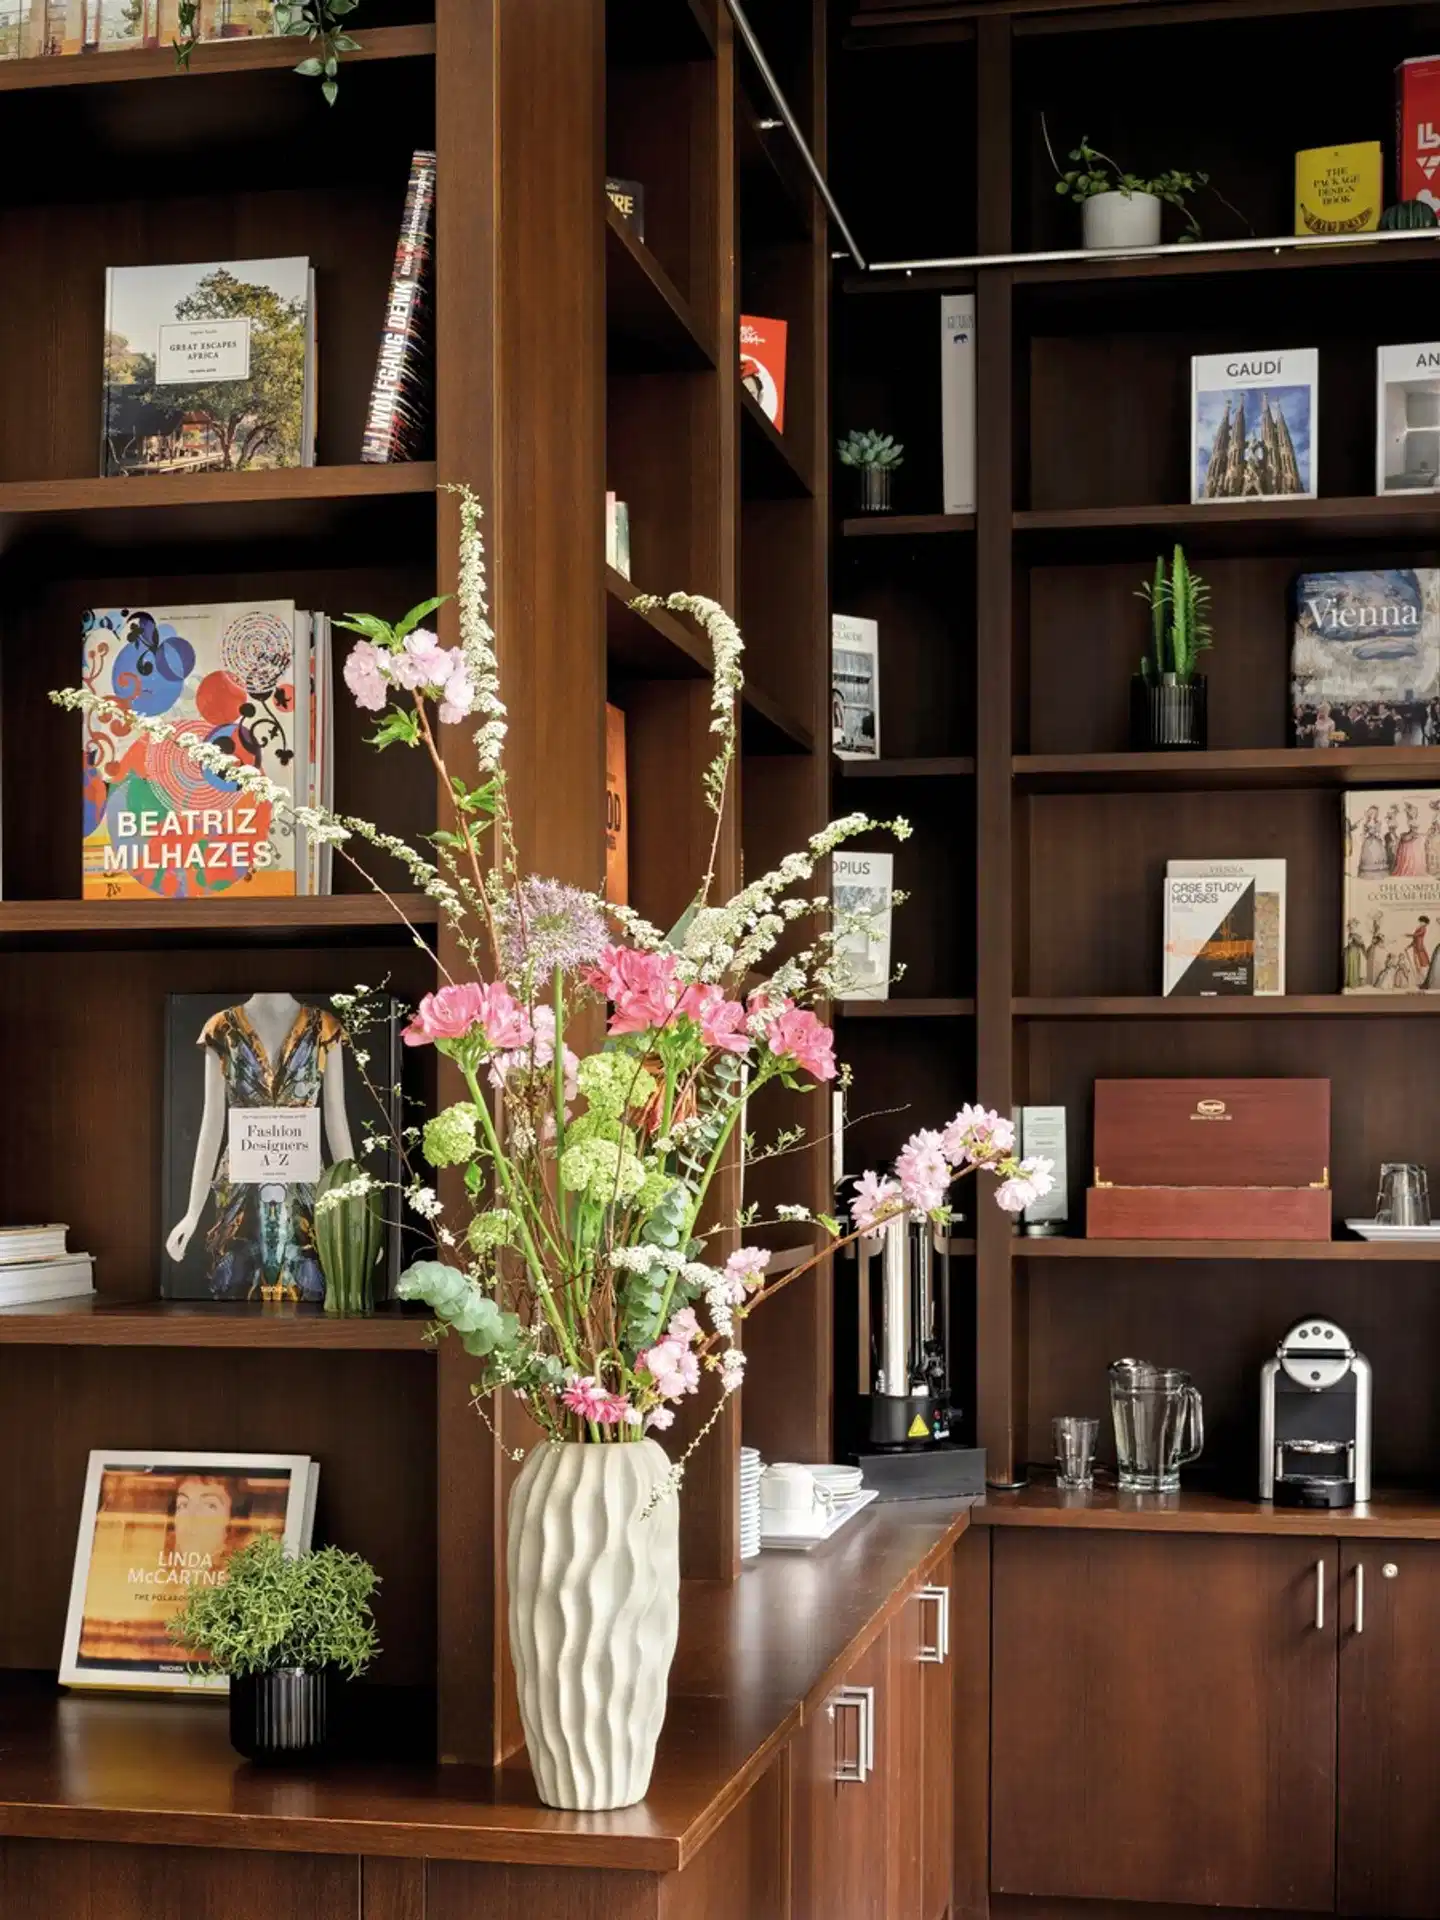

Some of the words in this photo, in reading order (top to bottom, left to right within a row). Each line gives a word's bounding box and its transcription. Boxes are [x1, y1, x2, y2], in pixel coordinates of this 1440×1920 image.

[1325, 167, 1349, 177] THE
[1312, 173, 1361, 188] PACKAGE
[1317, 185, 1356, 197] DESIGN
[169, 343, 199, 351] GREAT
[200, 340, 238, 349] ESCAPES
[187, 352, 219, 360] AFRICA
[369, 332, 405, 430] WOLFGANG
[387, 281, 415, 330] DENK
[1416, 352, 1440, 367] AN
[1226, 356, 1284, 377] GAUDÍ
[1304, 598, 1420, 628] Vienna
[117, 808, 257, 837] BEATRIZ
[103, 841, 272, 870] MILHAZES
[1171, 882, 1203, 894] CASE
[1205, 881, 1243, 893] STUDY
[1171, 893, 1220, 904] HOUSES
[247, 1124, 302, 1137] Fashion
[241, 1139, 309, 1154] Designers
[158, 1551, 213, 1568] LINDA
